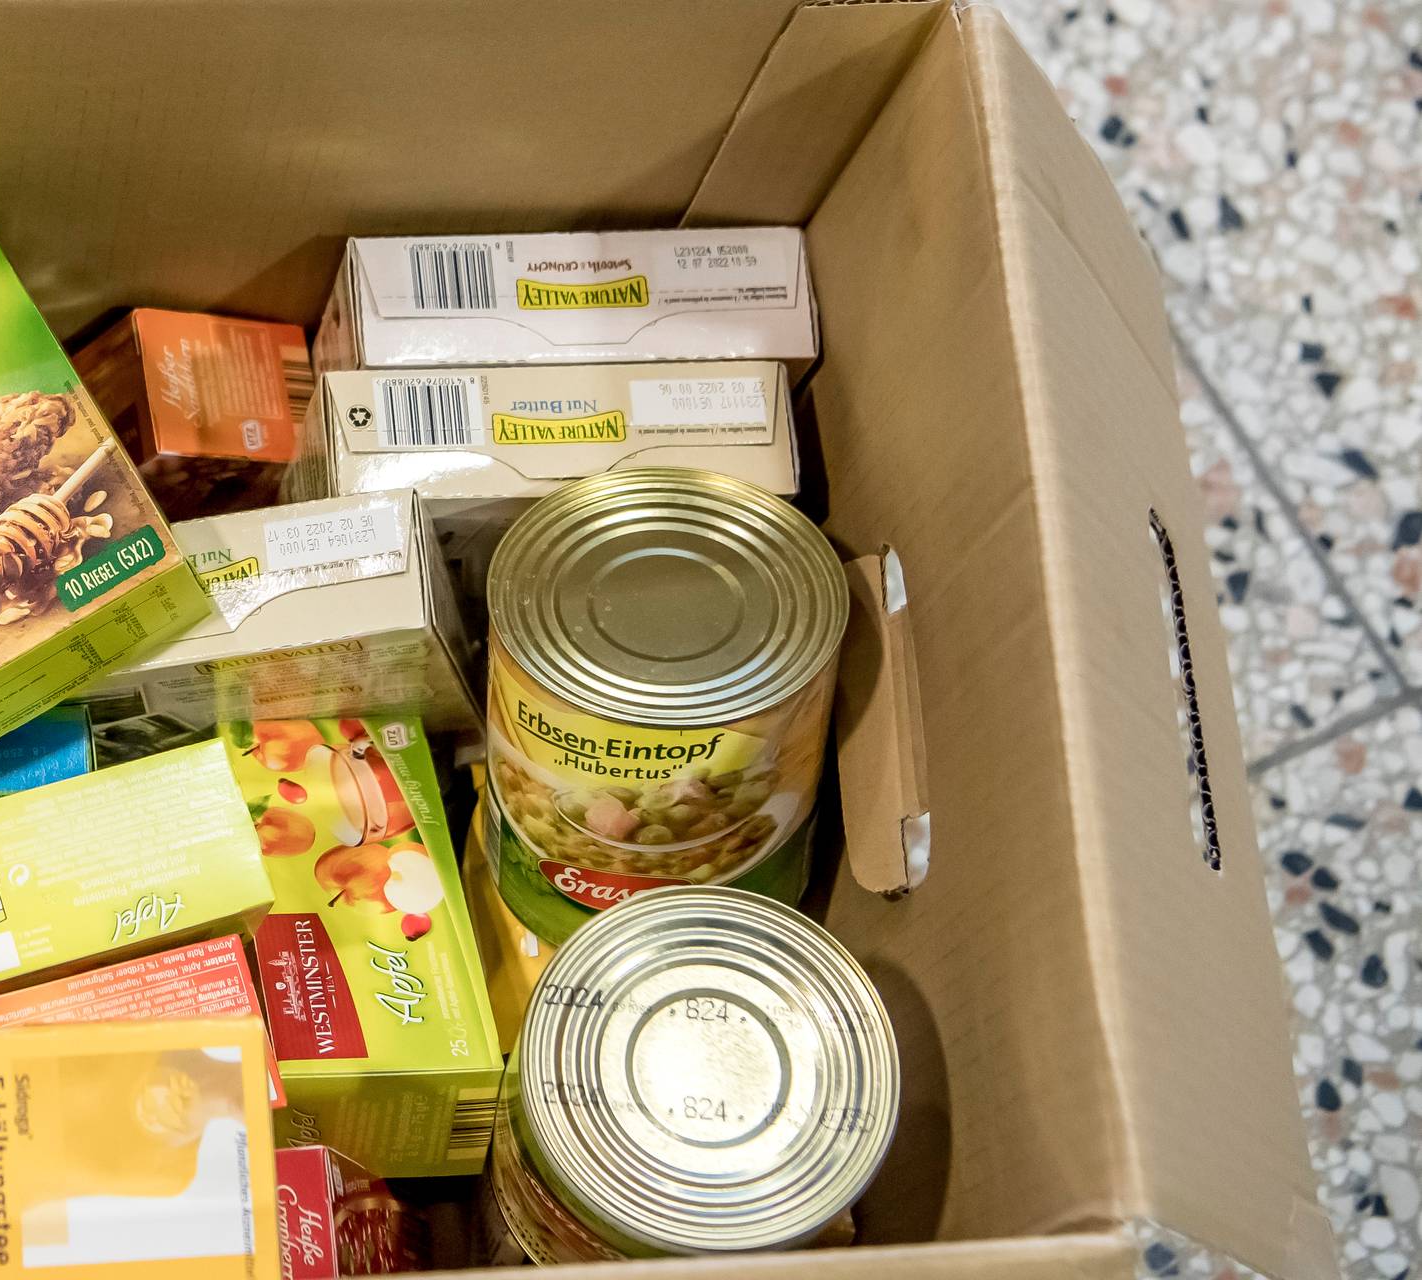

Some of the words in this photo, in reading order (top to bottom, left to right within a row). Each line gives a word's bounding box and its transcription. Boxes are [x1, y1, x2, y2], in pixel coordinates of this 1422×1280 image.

[526, 261, 578, 272] CRUNCHY
[587, 258, 631, 272] Smooth
[522, 283, 577, 306] VALLEY
[579, 279, 642, 304] NATURE
[426, 376, 461, 386] 410076
[696, 381, 724, 394] 2022
[509, 399, 562, 412] Butter
[565, 399, 596, 412] Nut
[498, 419, 555, 445] VALLEY
[557, 415, 619, 444] NATURE
[305, 520, 333, 535] 2022
[338, 517, 353, 529] 02
[359, 514, 373, 525] 05
[199, 547, 233, 565] Nut
[61, 576, 86, 601] 10
[78, 556, 120, 591] RIEGEL
[113, 534, 156, 571] (5X2)
[382, 726, 401, 748] UTZ
[518, 700, 724, 762] Erbsen-Eintopf
[102, 887, 189, 944] Apfel
[185, 946, 205, 960] Rote
[204, 938, 233, 954] Aroma,
[145, 958, 159, 970] 1%
[160, 950, 186, 966] Beete,
[177, 959, 202, 974] Apfel,
[202, 950, 237, 968] Zutaten:
[114, 962, 145, 978] Erdbeer
[198, 978, 226, 993] Minuten
[225, 975, 239, 986] 5-8
[293, 917, 336, 1055] WESTMINSTER
[325, 974, 336, 993] TEA
[366, 932, 432, 1029] Apfel
[197, 983, 241, 1003] Zubereitung:
[235, 994, 249, 1005] Ein
[685, 998, 729, 1021] 824
[448, 1037, 470, 1058] 25
[682, 1095, 726, 1121] 824
[294, 1205, 323, 1265] Heiße
